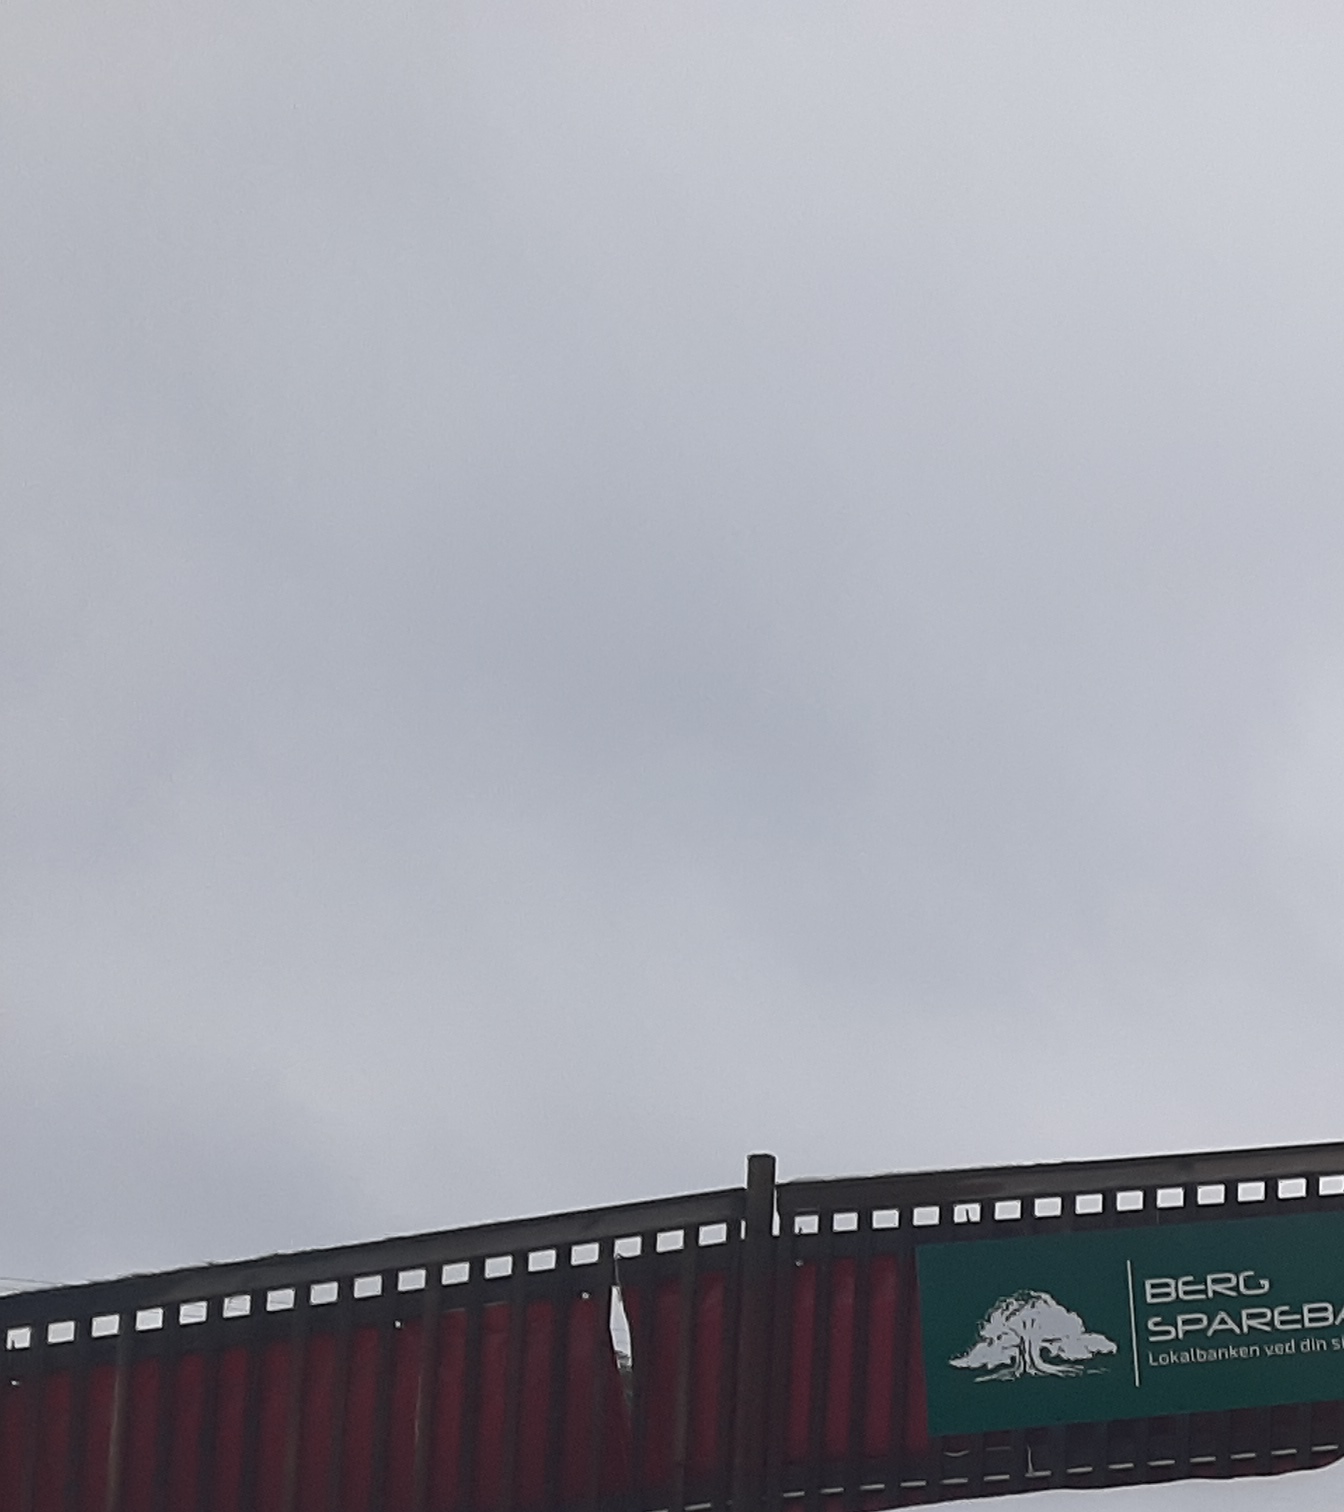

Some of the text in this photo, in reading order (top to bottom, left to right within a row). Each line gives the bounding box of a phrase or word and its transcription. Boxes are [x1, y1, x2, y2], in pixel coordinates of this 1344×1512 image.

[1144, 1270, 1269, 1304] BERG
[1149, 1345, 1260, 1366] Lokalbanken
[1264, 1339, 1296, 1356] ved
[1300, 1337, 1328, 1352] din
